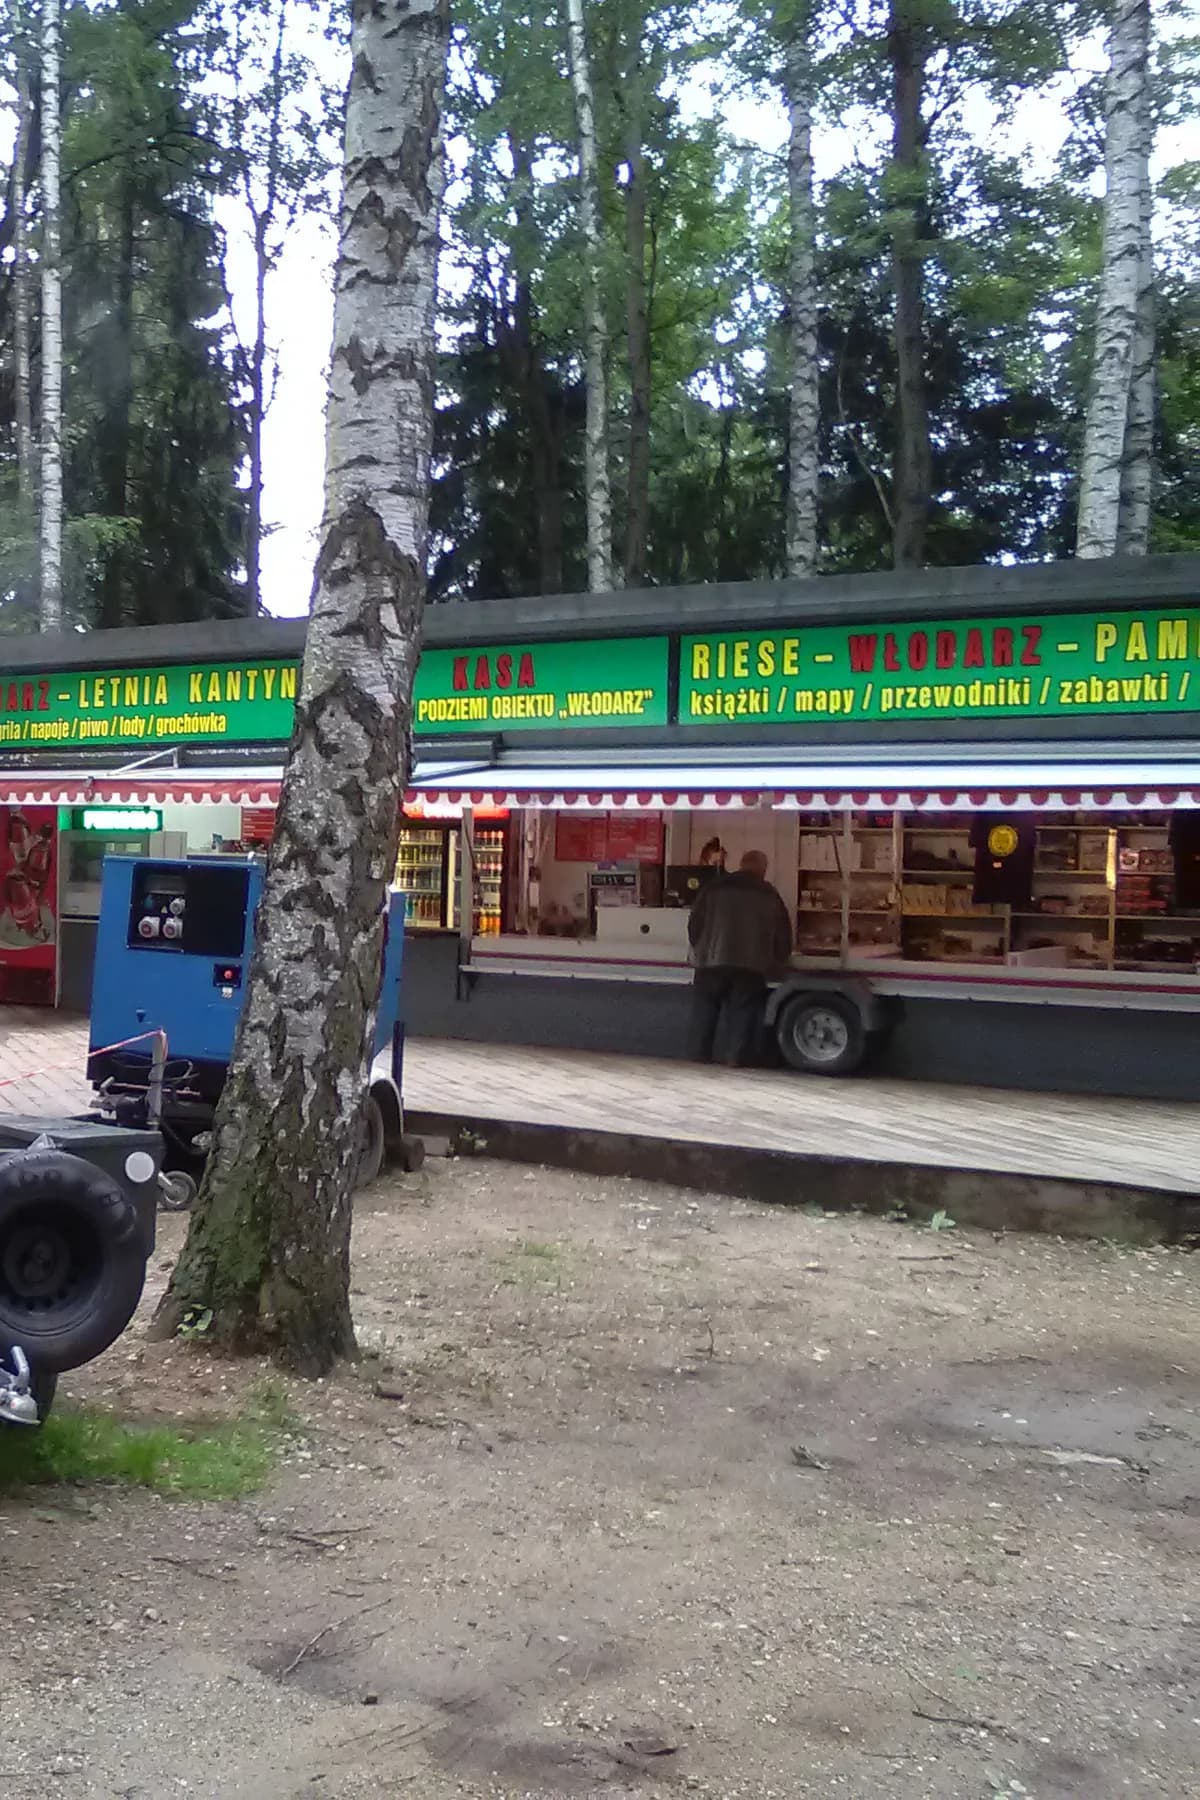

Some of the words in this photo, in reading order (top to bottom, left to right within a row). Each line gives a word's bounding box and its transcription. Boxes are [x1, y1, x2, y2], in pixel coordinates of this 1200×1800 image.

[692, 638, 800, 680] RIESE
[849, 626, 1042, 672] WŁODARZ
[1095, 619, 1200, 662] PAM
[79, 675, 168, 708] LETNIA
[188, 667, 297, 703] KANTYN
[452, 653, 536, 690] KASA
[417, 696, 488, 722] PODZIEMI
[492, 693, 555, 719] OBIEKTU
[690, 687, 770, 720] książki
[795, 687, 855, 714] mapy
[881, 677, 1031, 712] przewodniki
[1059, 672, 1169, 704] zabawki
[31, 717, 69, 741] napoje
[79, 716, 109, 740] piwo
[119, 714, 146, 738] lody
[156, 711, 227, 737] grochówka
